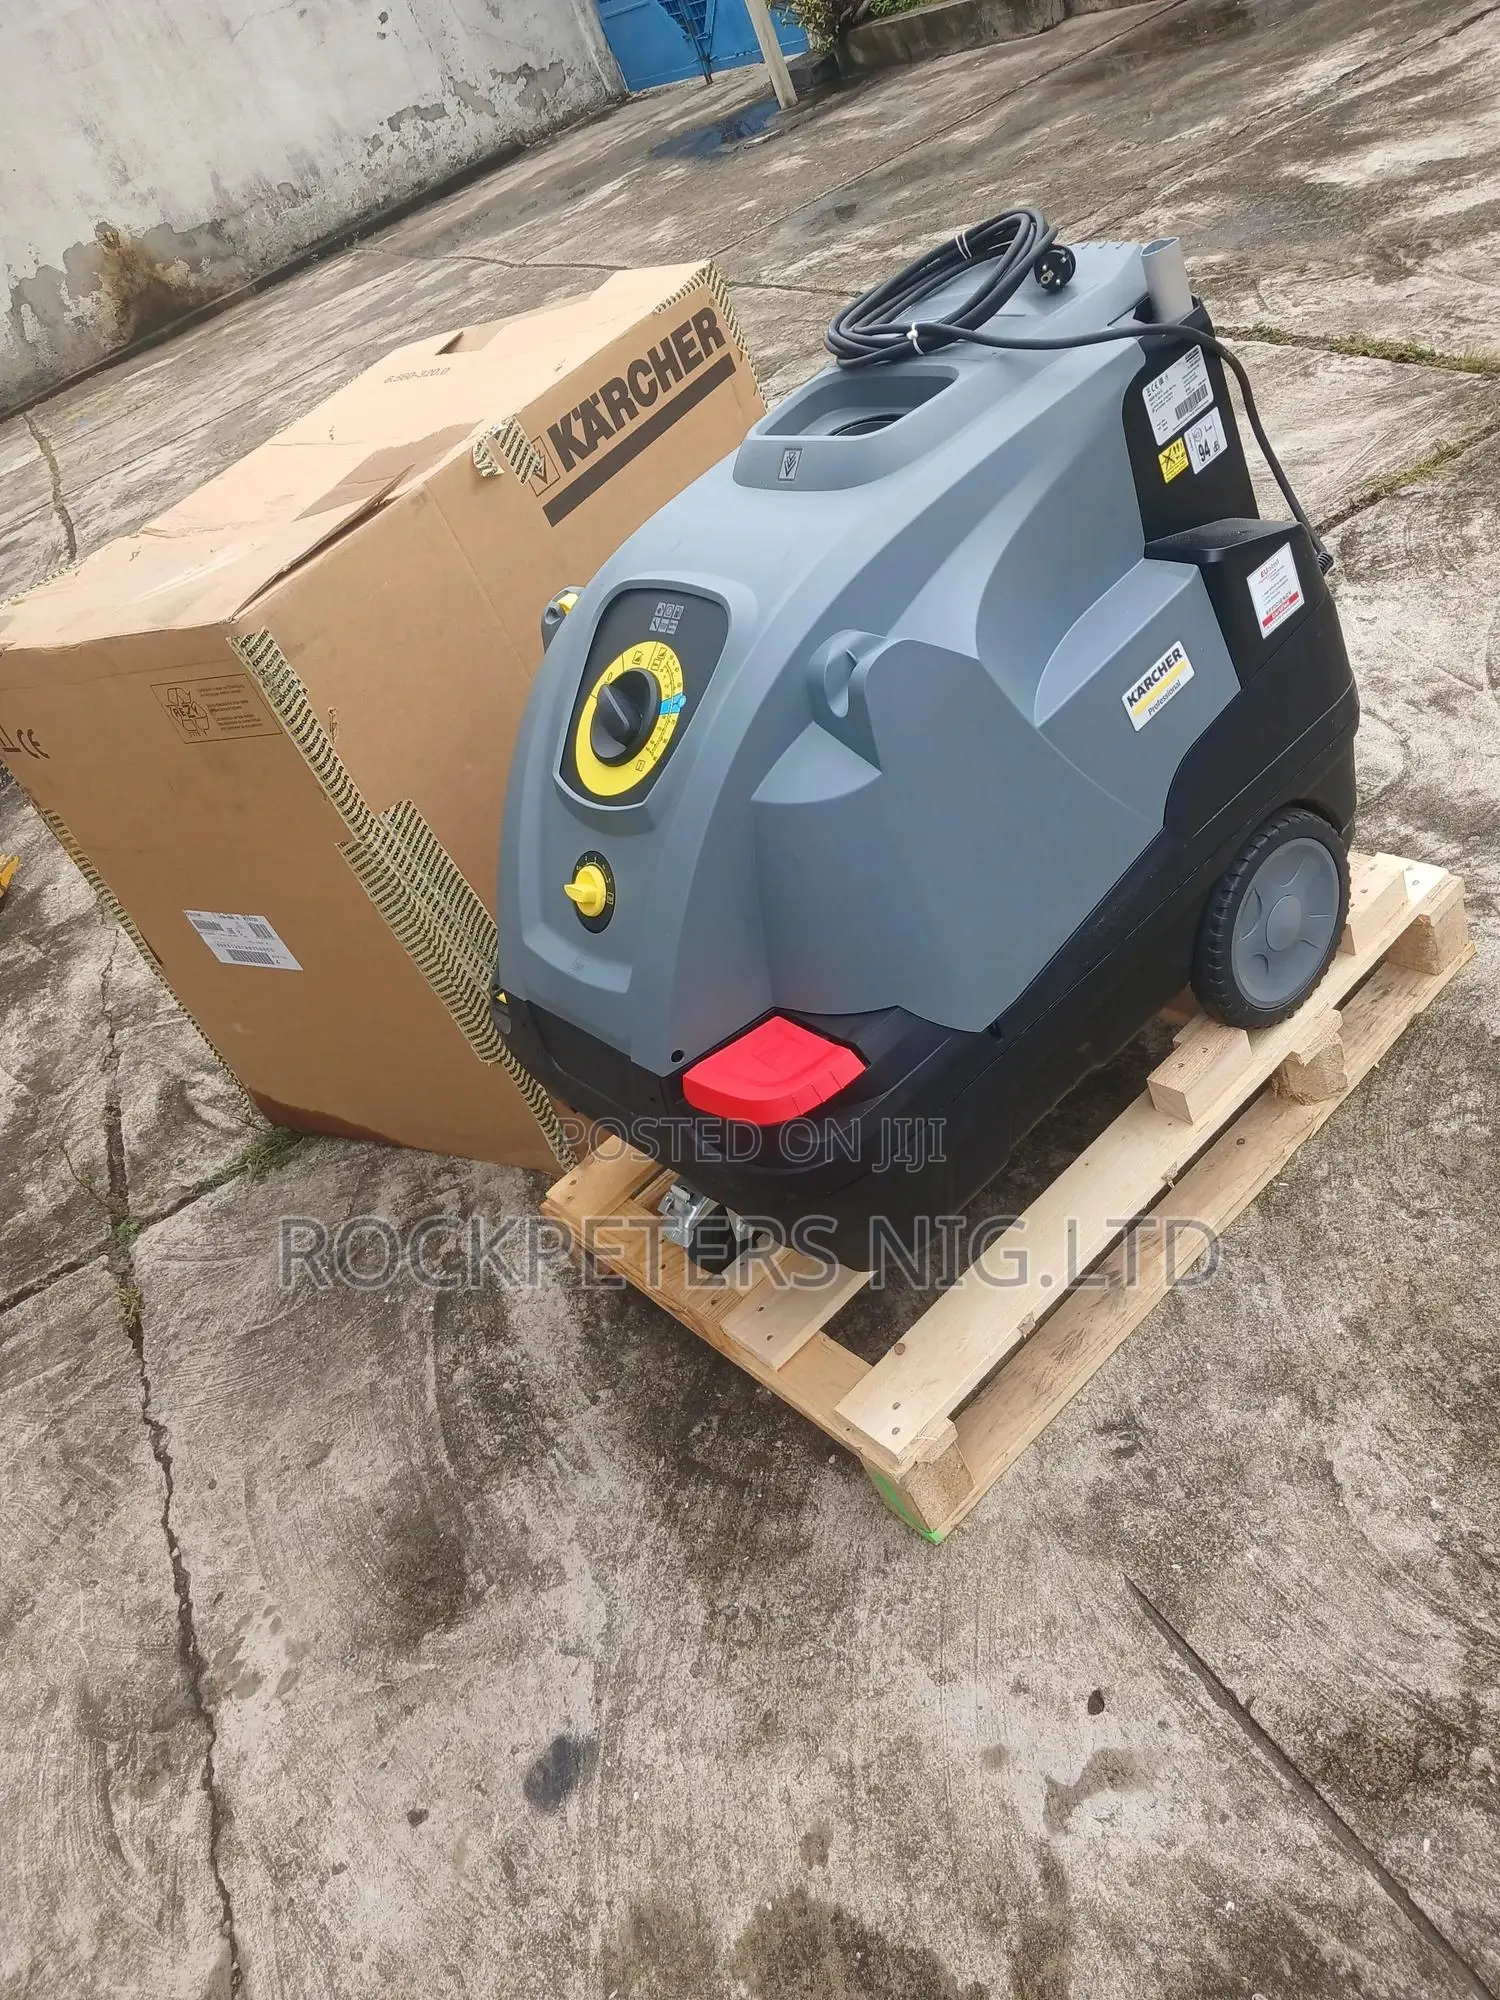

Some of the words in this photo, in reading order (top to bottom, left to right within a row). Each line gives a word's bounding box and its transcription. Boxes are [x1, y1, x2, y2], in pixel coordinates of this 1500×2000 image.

[547, 307, 726, 473] KÄRCHER
[1198, 438, 1210, 462] 94
[1126, 647, 1183, 708] KÄRCHER
[1147, 680, 1181, 716] Professional
